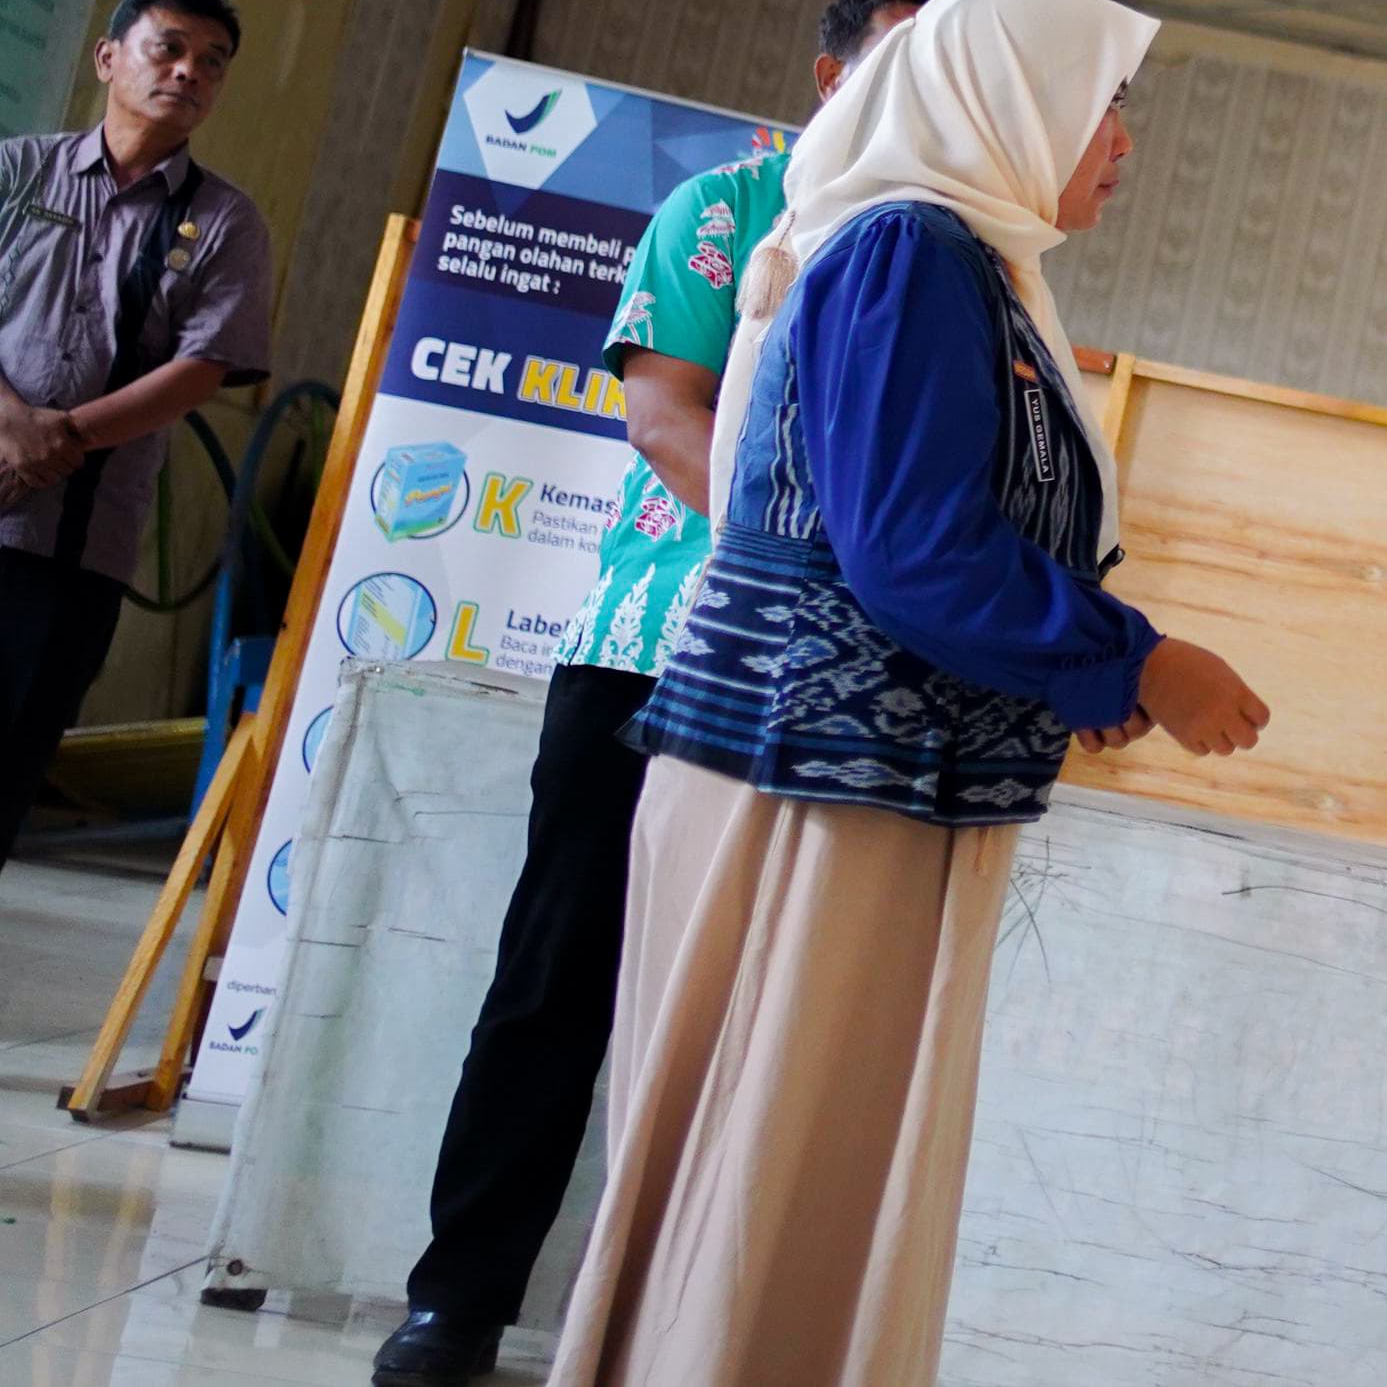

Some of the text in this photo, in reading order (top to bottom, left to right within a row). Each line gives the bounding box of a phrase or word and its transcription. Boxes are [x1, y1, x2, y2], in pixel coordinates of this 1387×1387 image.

[486, 135, 557, 158] BADAN POM
[450, 205, 535, 240] Sebelum
[538, 227, 622, 259] membeli
[442, 231, 516, 261] pangan
[520, 245, 585, 275] olahan
[438, 255, 496, 281] selalu
[500, 263, 551, 293] ingat
[410, 336, 512, 394] CEK
[1032, 398, 1050, 473] YUB GEMALA
[474, 471, 533, 538] K
[533, 510, 598, 535] Pastikan
[528, 528, 575, 549] dalam
[445, 600, 489, 666] L
[500, 634, 537, 655] Baca
[209, 1041, 241, 1054] BADAN
